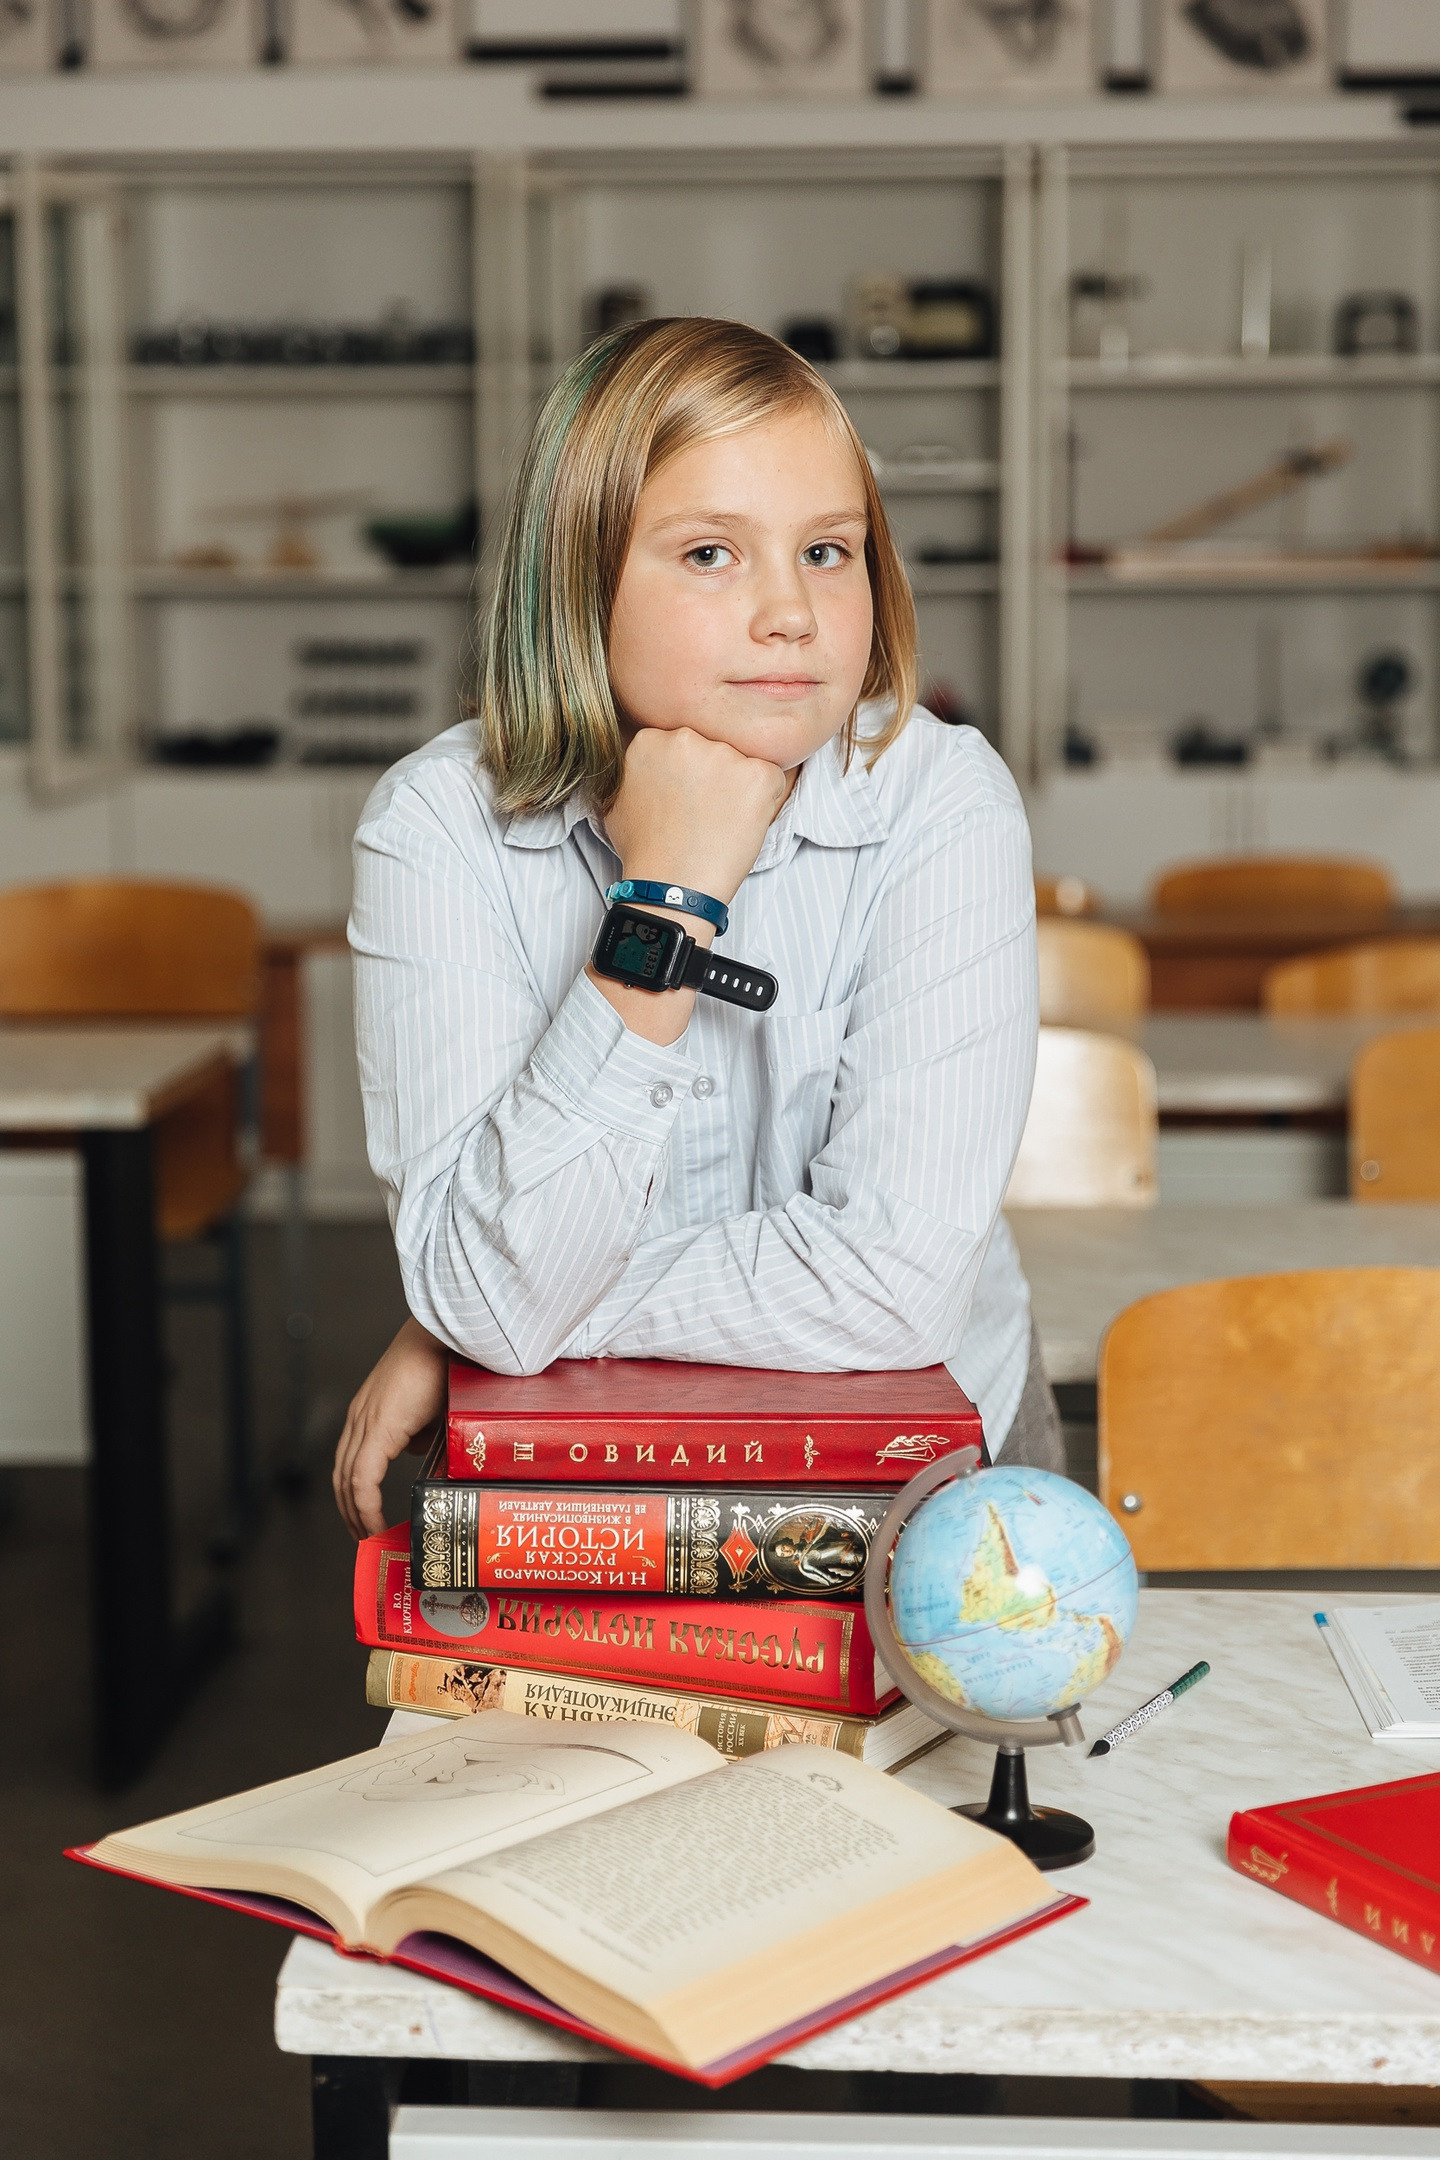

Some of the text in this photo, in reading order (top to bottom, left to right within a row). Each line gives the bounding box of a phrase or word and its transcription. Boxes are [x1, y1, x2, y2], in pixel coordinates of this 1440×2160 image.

[569, 1440, 764, 1466] ОВИДИЙ
[498, 1500, 647, 1516] ЕЁ ГЛАВНЕЙШИХ ДЕЯТЕЛЕЙ
[512, 1513, 632, 1525] В ЖИЗНЕОПИСАНИЯХ
[496, 1525, 645, 1551] ИСТОРИЯ
[525, 1550, 617, 1566] РУССКАЯ
[496, 1597, 828, 1674] РУССКАЯ ИСТОРИЯ
[525, 1683, 678, 1722] ЭНЦИКЛОПЕДИЯ
[717, 1712, 727, 1751] ИСТОРИЯ
[726, 1713, 738, 1753] РОССИИ
